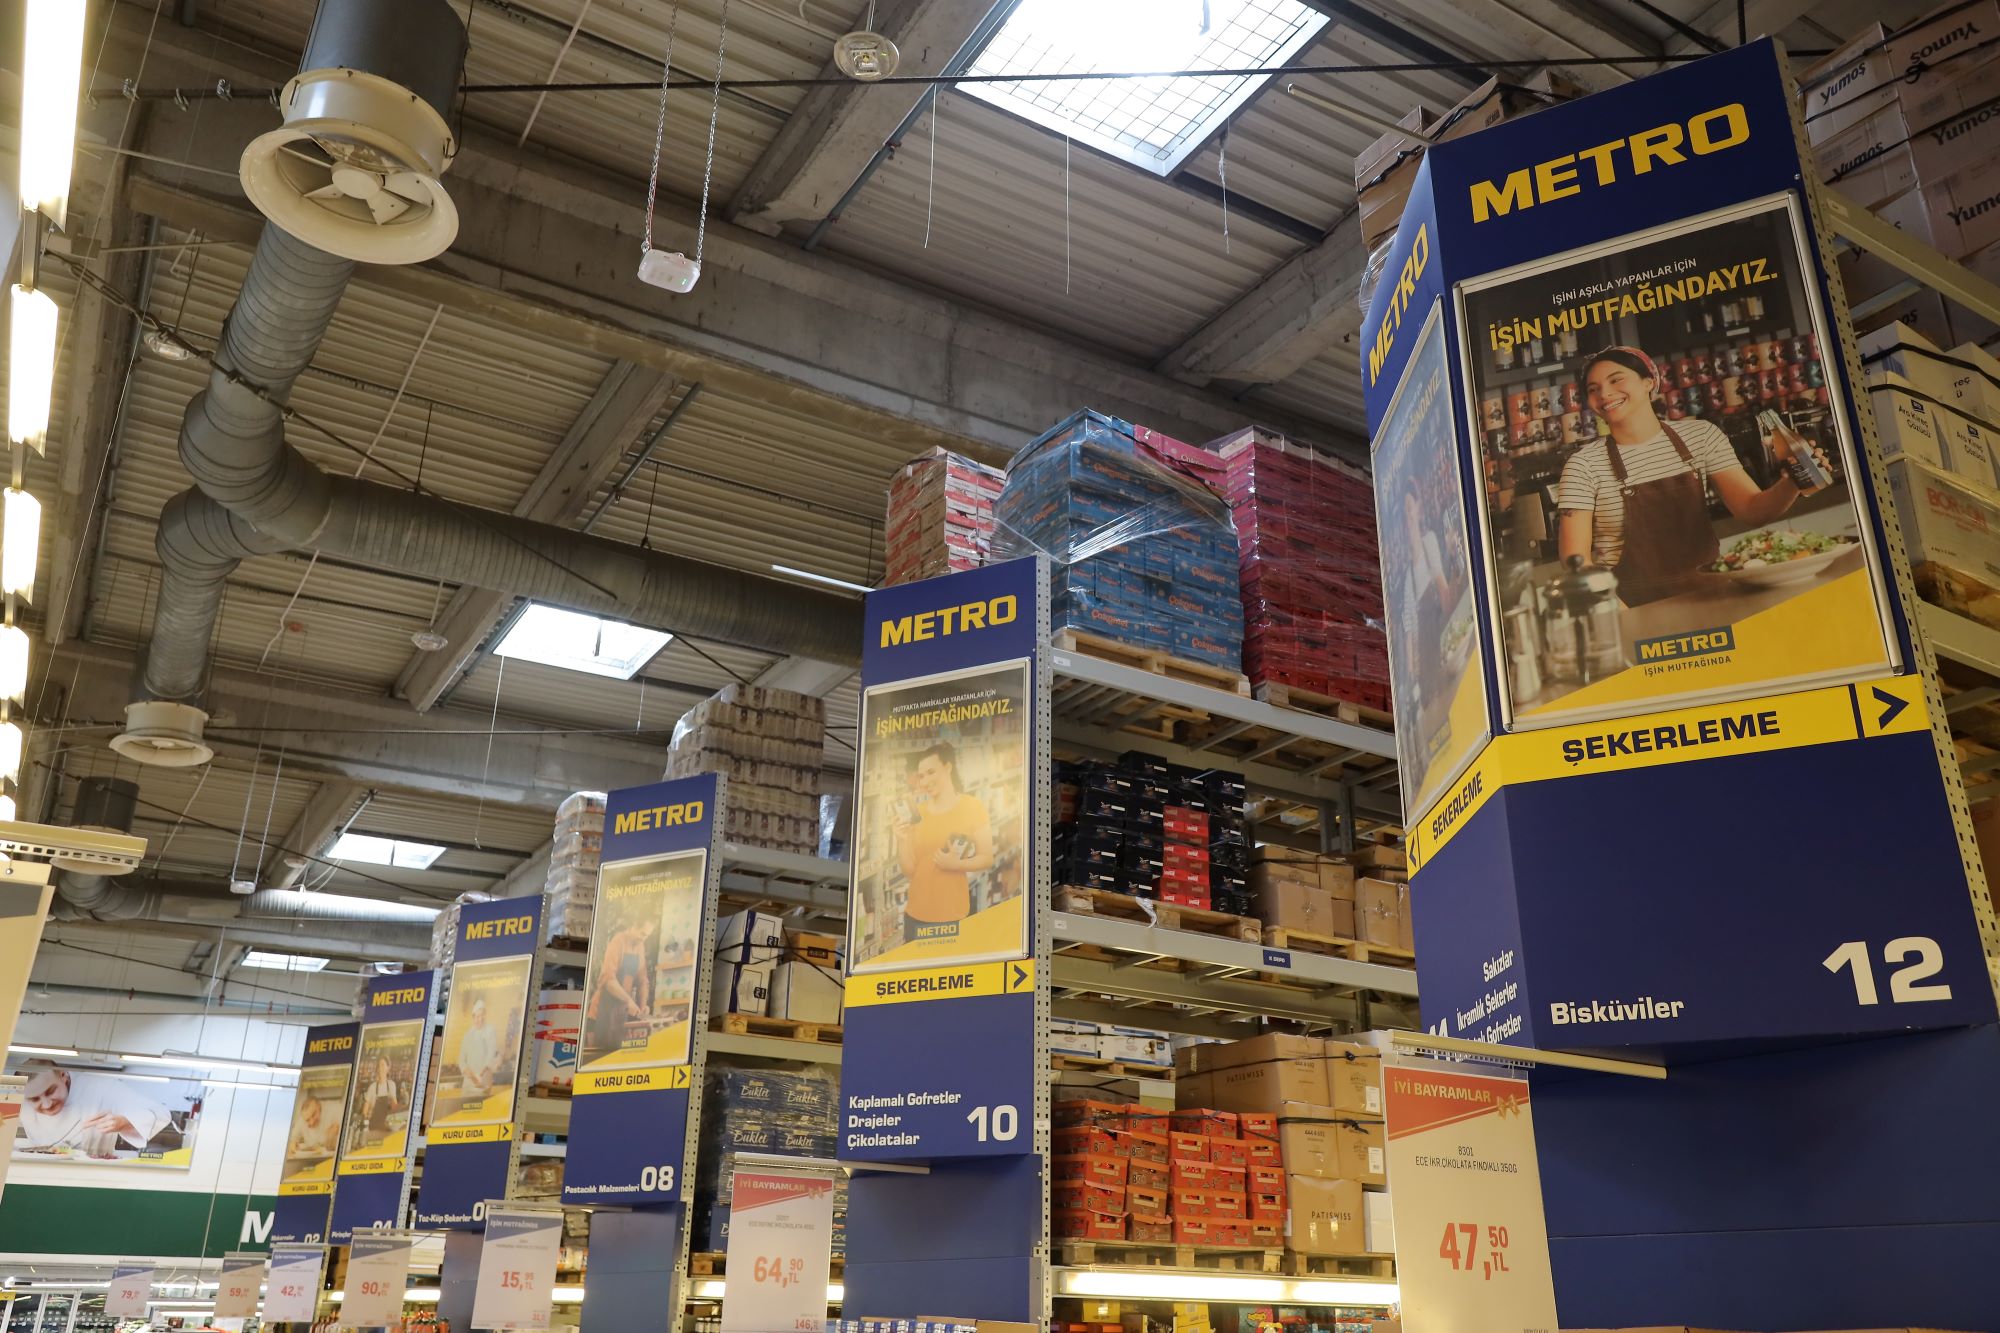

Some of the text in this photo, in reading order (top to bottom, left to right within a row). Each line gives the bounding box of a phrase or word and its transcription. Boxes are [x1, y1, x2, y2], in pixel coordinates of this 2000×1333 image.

[1469, 103, 1750, 223] METRO
[1552, 258, 1697, 305] İŞİNİ AŞKLA YAPANLAR İÇİN
[1369, 223, 1429, 388] METRO
[1489, 257, 1778, 354] İŞİN MUTFAĞINDAYIZ.
[880, 594, 1017, 648] METRO
[1640, 631, 1729, 659] METRO
[1644, 655, 1731, 677] İŞİN MUTFAĞINDA
[876, 698, 1013, 738] İŞİN MUTFAĞINDAYIZ.
[1562, 710, 1780, 767] ŞEKERLEME
[615, 801, 704, 835] METRO
[1432, 771, 1483, 843] ŞEKERLEME
[465, 916, 533, 940] METRO
[917, 924, 956, 937] METRO
[1483, 949, 1513, 982] Sakızlar
[1822, 936, 1952, 1006] 12
[372, 987, 425, 1006] METRO
[876, 974, 974, 999] ŞEKERLEME
[1456, 981, 1517, 1031] İkramlık Şekerler
[1550, 996, 1685, 1025] Bisküviler
[1486, 1014, 1522, 1044] Gofretler
[309, 1036, 352, 1053] METRO
[621, 1039, 647, 1048] METRO
[595, 1074, 650, 1088] KURU GIDA
[1394, 1076, 1491, 1103] İYİ BAYRAMLAR
[849, 1090, 961, 1111] Kaplamalı Gofretler
[443, 1129, 483, 1139] KURU GIDA
[848, 1113, 901, 1130] Drajeler
[967, 1104, 1018, 1142] 10
[847, 1132, 920, 1150] Çikolatalar
[1415, 1156, 1429, 1167] ECE
[641, 1166, 674, 1192] 08
[740, 1178, 806, 1192] İYİ BAYRAMLAR
[1311, 1211, 1351, 1221] PATISWISS
[1488, 1226, 1509, 1248] 50
[790, 1259, 804, 1271] 90
[1491, 1251, 1509, 1272] TL
[788, 1272, 800, 1284] TL
